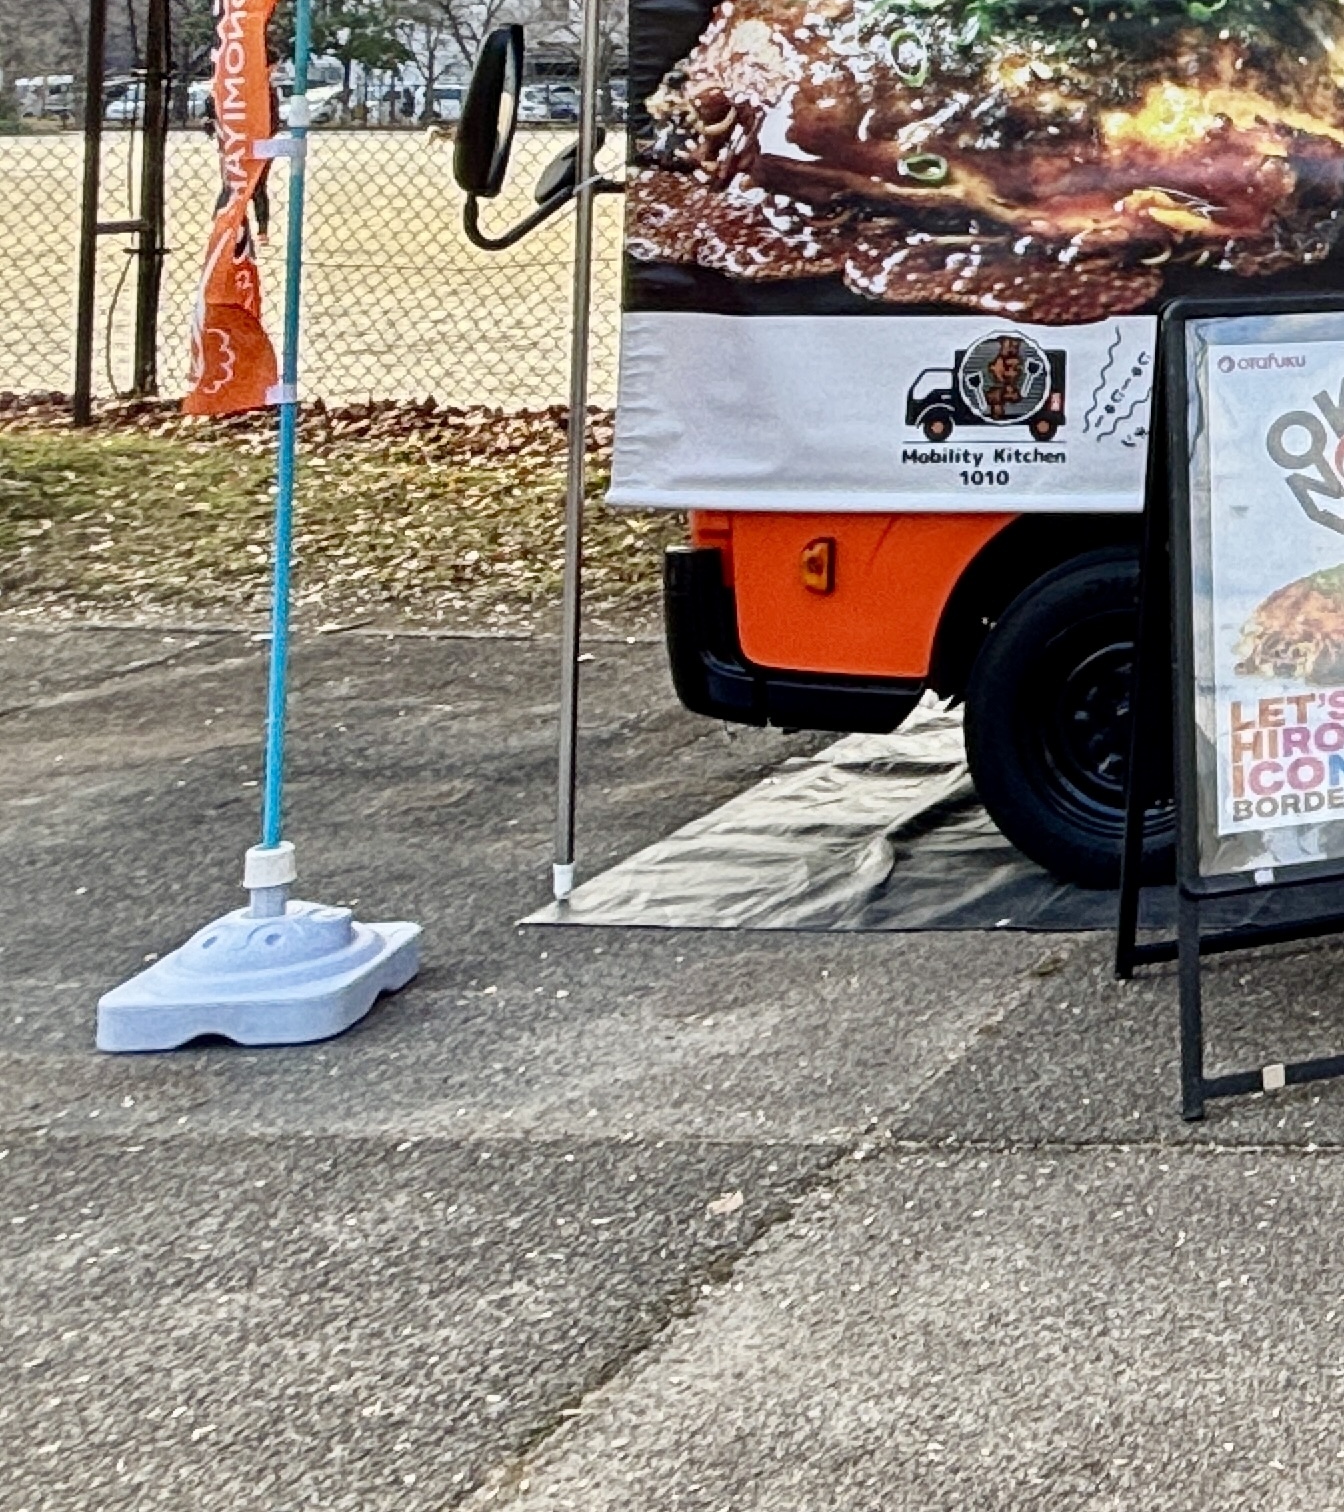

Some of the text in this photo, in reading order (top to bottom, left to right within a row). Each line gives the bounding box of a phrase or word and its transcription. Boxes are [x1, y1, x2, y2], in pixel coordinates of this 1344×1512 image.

[902, 448, 1067, 467] Mobility Kitchen
[959, 470, 1010, 486] 1010
